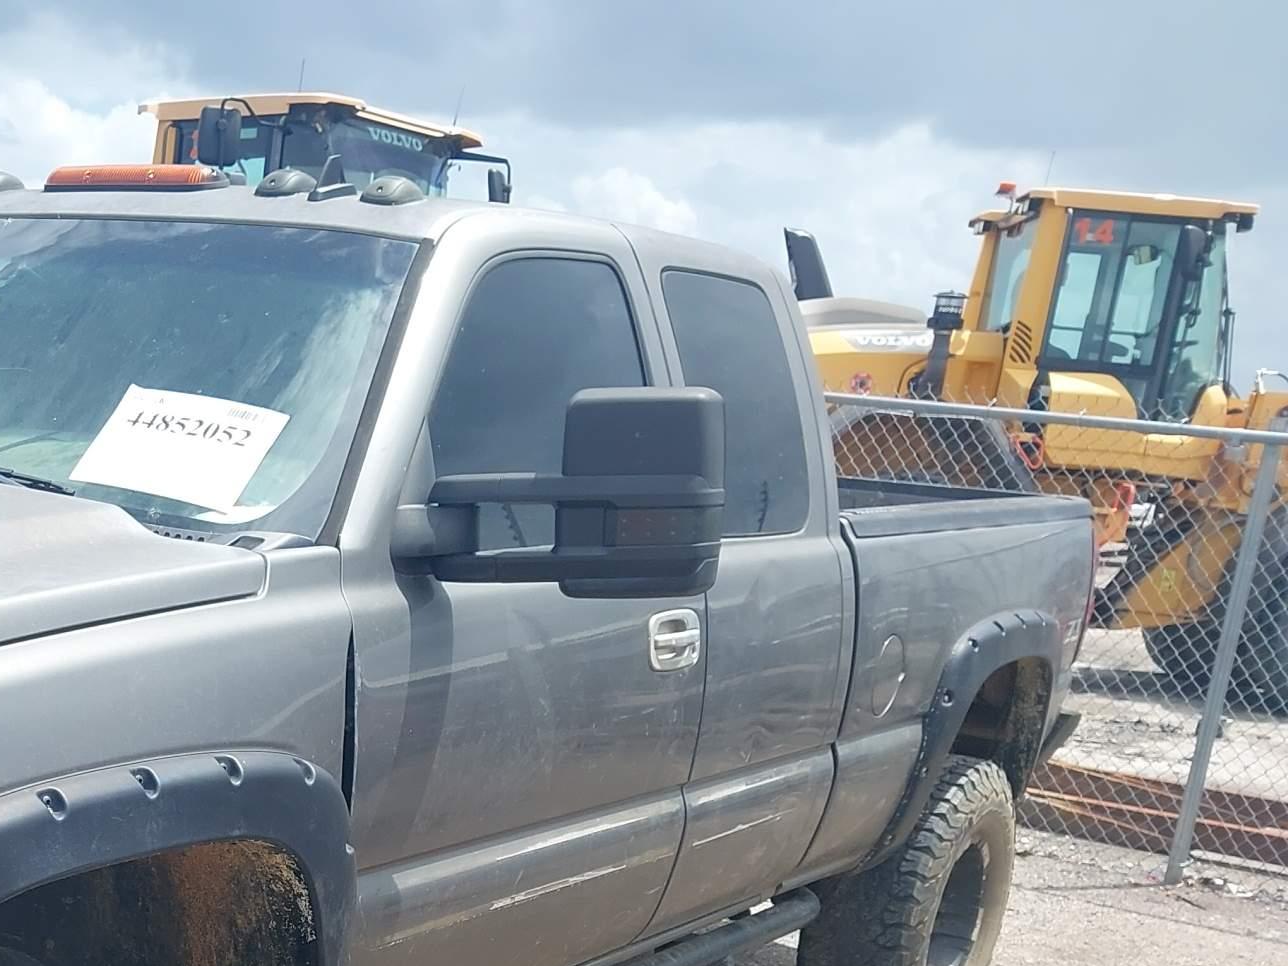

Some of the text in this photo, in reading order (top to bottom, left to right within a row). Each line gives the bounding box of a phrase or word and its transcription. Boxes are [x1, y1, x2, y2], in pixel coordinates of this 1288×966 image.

[367, 126, 424, 152] VOLVO
[855, 334, 932, 347] VOLVO
[126, 410, 253, 448] 44852052
